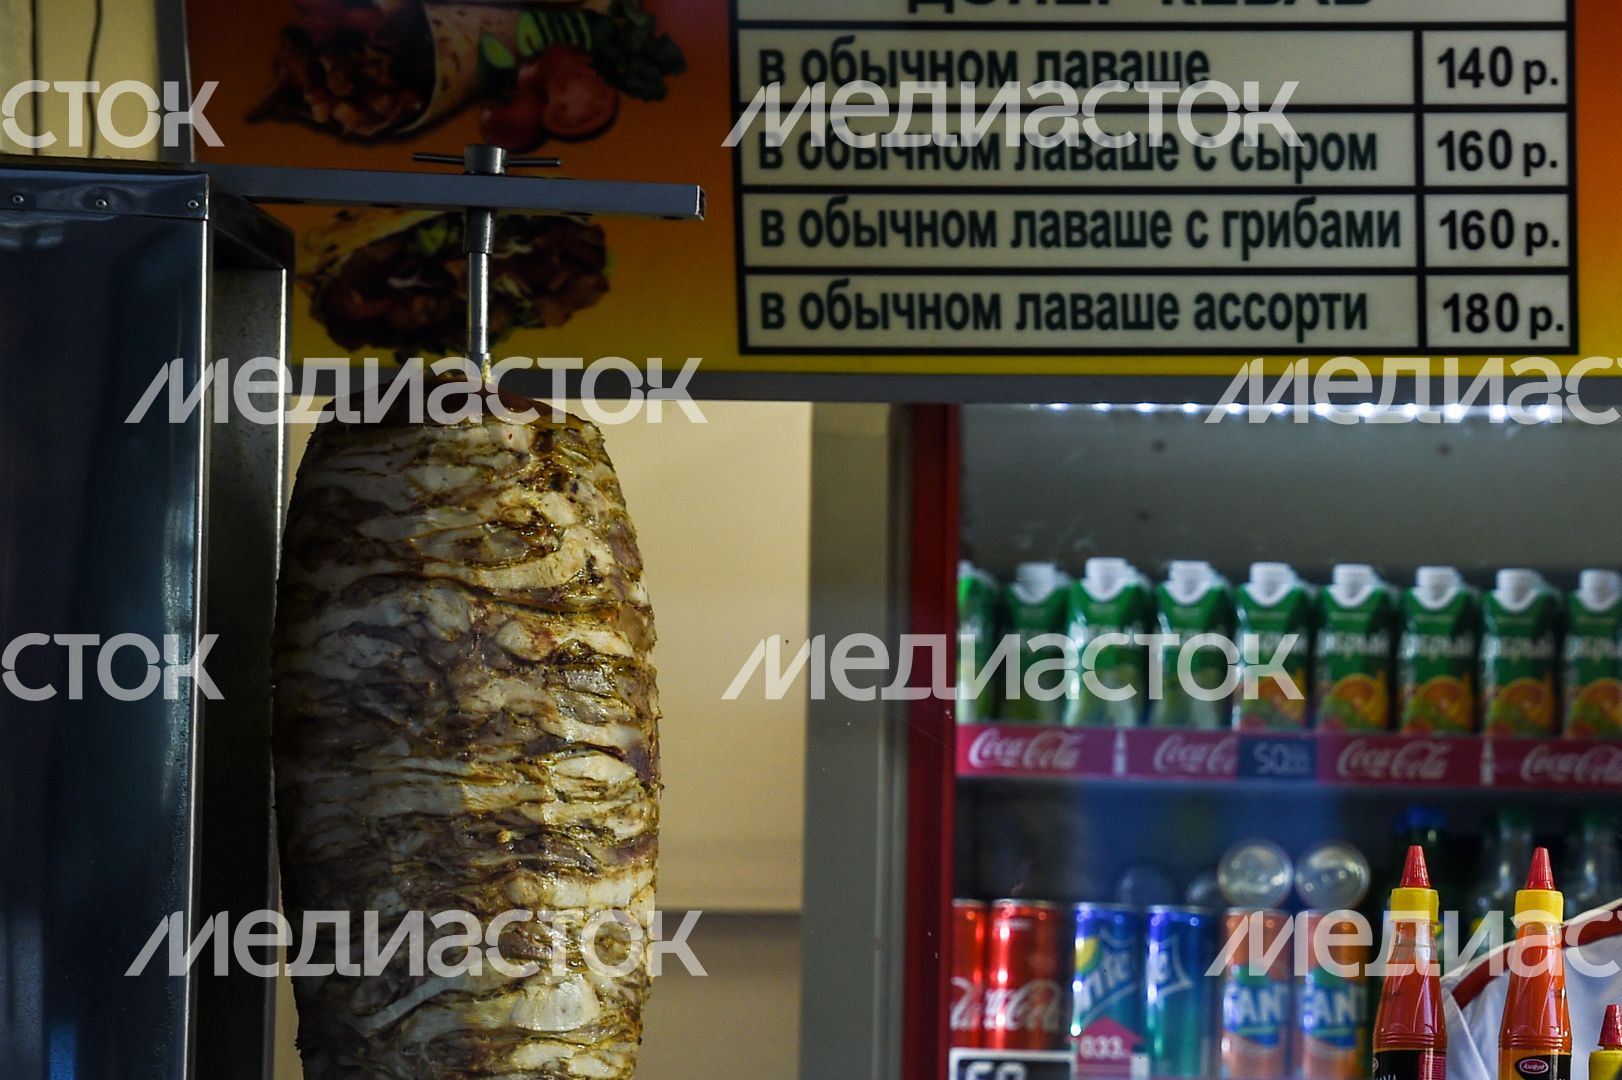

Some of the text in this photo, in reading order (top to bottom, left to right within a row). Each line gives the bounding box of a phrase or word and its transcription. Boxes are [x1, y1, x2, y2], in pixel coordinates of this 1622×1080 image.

[759, 37, 1559, 94] в обычном лаваше 140 р.
[1014, 132, 1190, 173] лаваше
[1197, 134, 1223, 173] с
[1231, 132, 1378, 184] сыром
[1437, 129, 1514, 173] 160
[1523, 136, 1559, 177] р.
[760, 198, 1561, 262] в обычном лаваше с грибами 160 р.
[760, 278, 1565, 343] в обычном лаваше ассорти 180 р.
